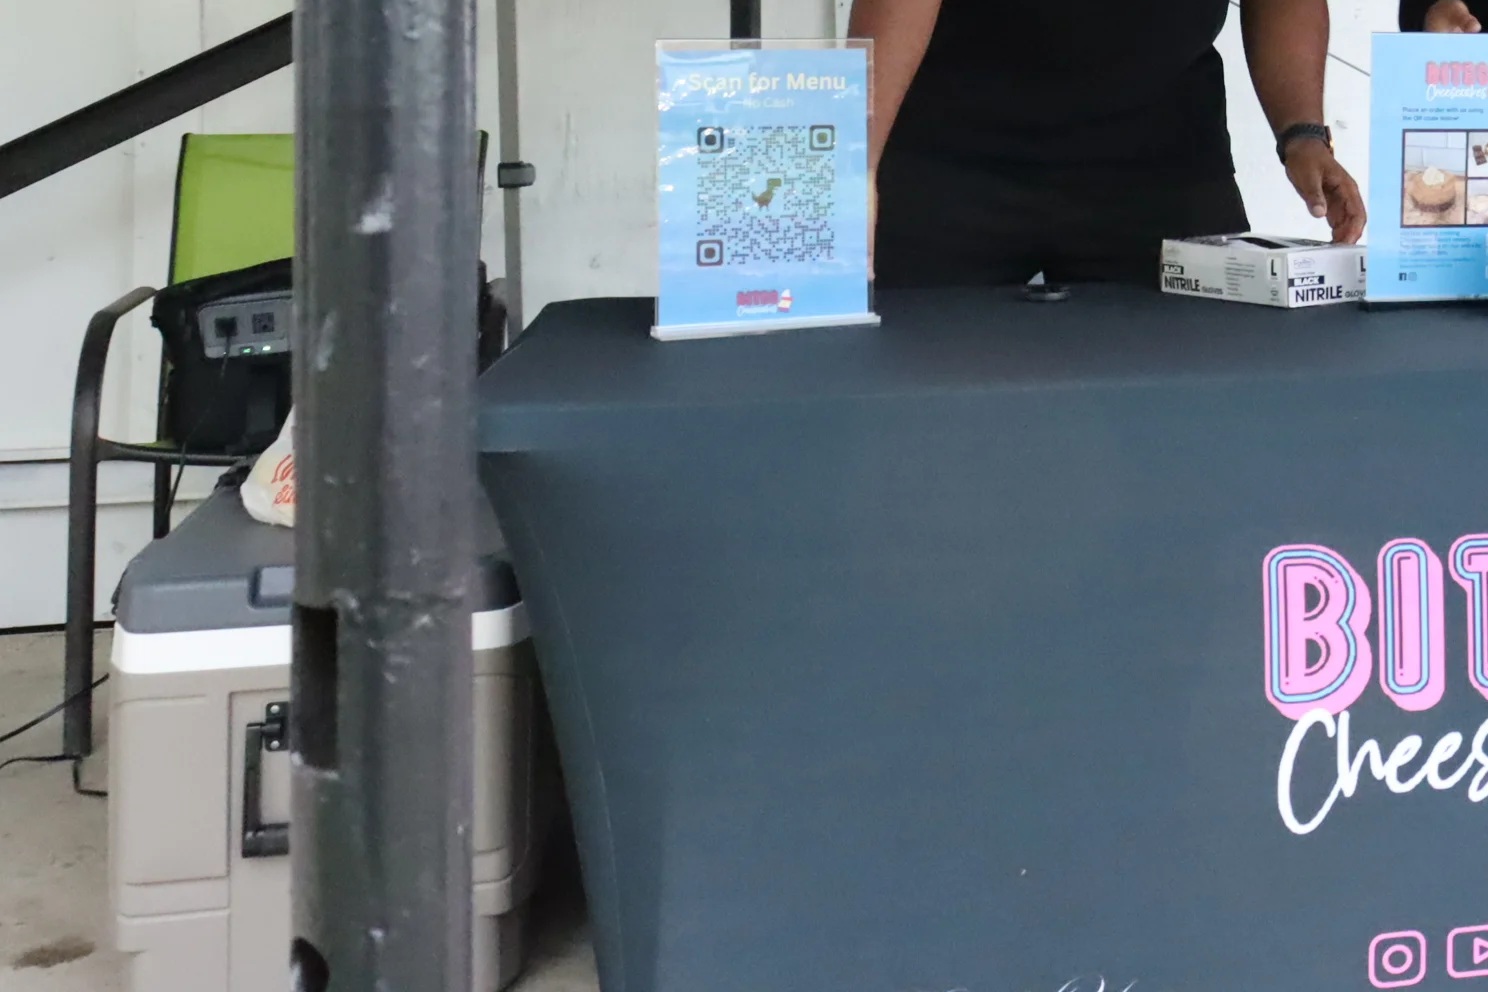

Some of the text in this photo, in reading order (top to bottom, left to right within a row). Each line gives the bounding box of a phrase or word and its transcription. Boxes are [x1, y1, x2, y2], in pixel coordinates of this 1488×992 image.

[688, 72, 846, 91] Scan for Menu
[1163, 265, 1182, 275] BLACK
[1270, 258, 1278, 277] L
[1164, 275, 1200, 292] NITRILE
[1294, 276, 1320, 286] BLACK
[1295, 285, 1343, 303] NITRILE
